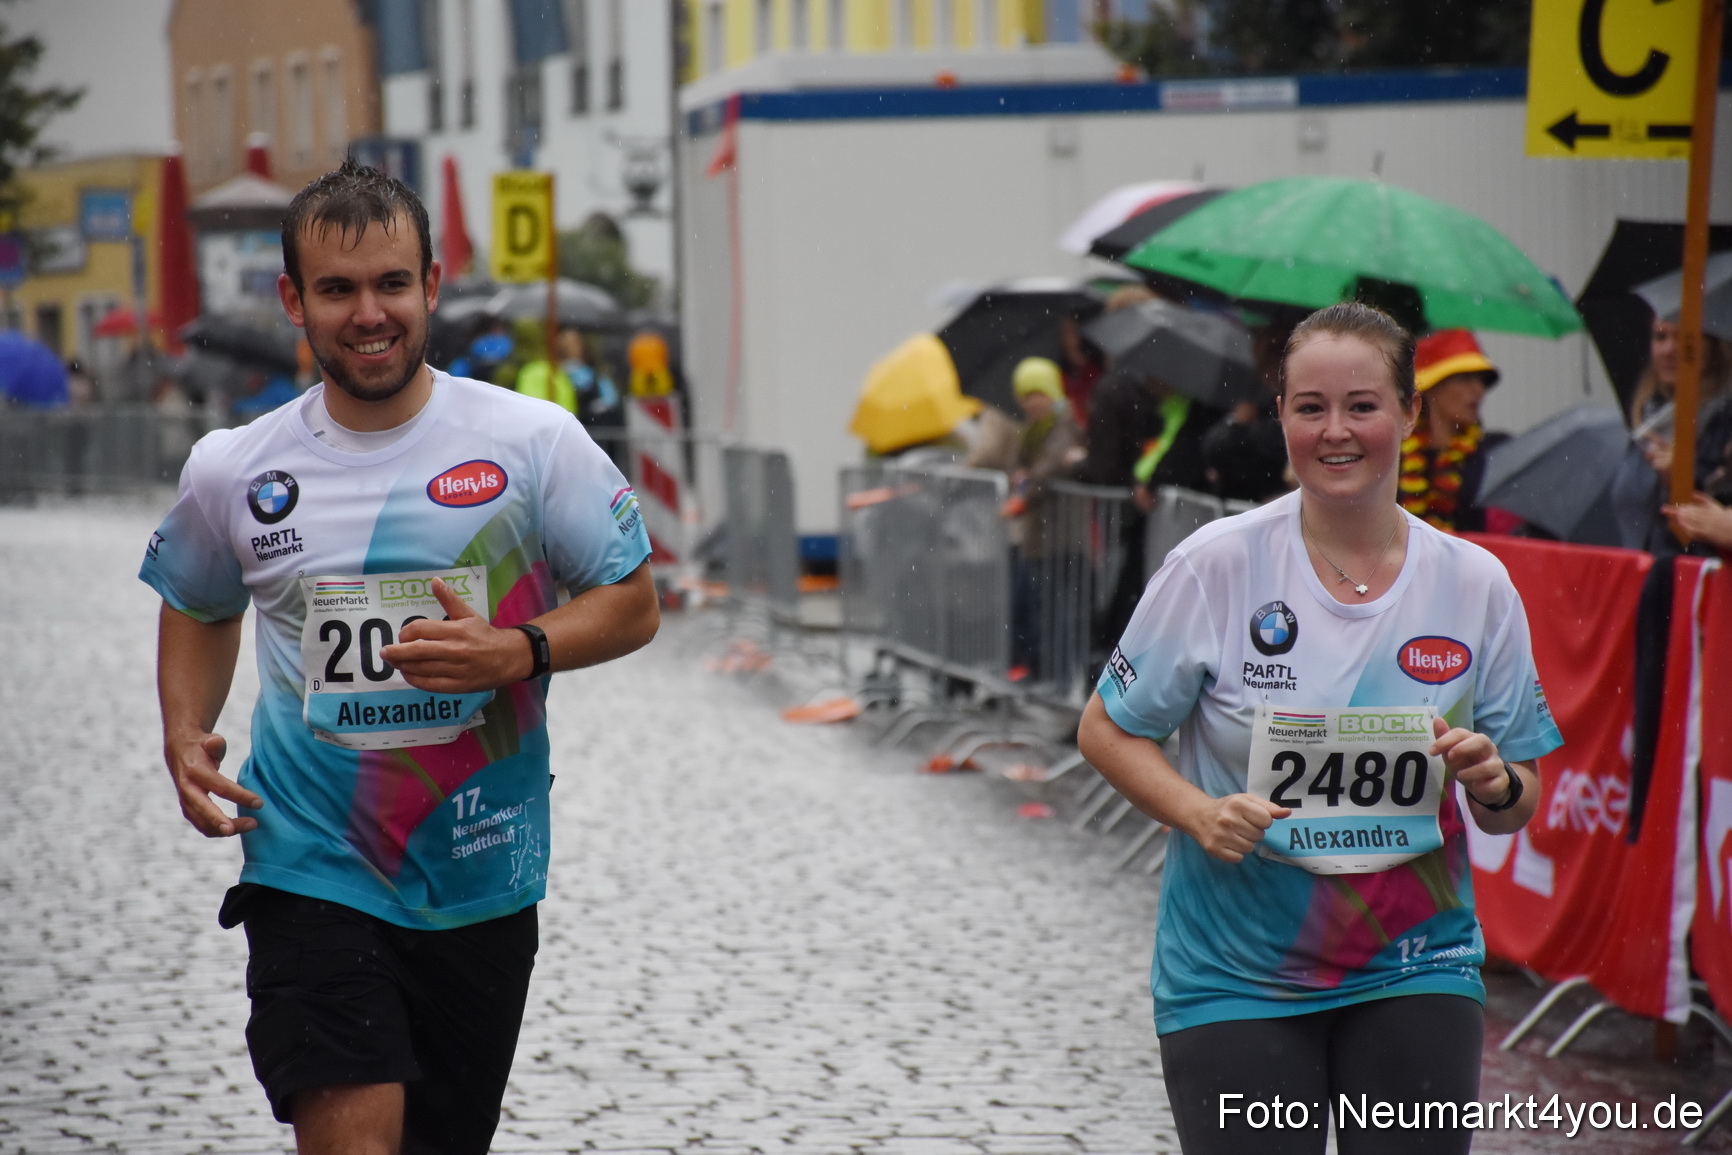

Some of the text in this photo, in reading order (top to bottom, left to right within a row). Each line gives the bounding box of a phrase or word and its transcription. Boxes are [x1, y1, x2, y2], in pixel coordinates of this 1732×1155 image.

[1579, 0, 1670, 97] C
[508, 204, 540, 257] D
[250, 471, 296, 492] BMW
[438, 471, 499, 496] Hervis
[251, 527, 303, 552] PARTL
[256, 542, 304, 562] Neumarkt
[312, 596, 369, 607] NeuerMarkt
[410, 600, 420, 608] by
[1255, 602, 1296, 624] BMW
[319, 614, 452, 683] 20
[1408, 647, 1463, 672] Hervis
[1242, 661, 1298, 680] PARTL
[1242, 676, 1297, 691] Neumarkt
[336, 696, 463, 727] Alexander
[1338, 713, 1428, 734] BOCK
[1267, 726, 1328, 738] NeuerMarkt
[1269, 750, 1429, 809] 2480
[451, 786, 486, 820] 17.
[452, 803, 523, 840] Neumarkter
[451, 824, 516, 859] Stadtlauf
[1289, 824, 1410, 851] Alexandra
